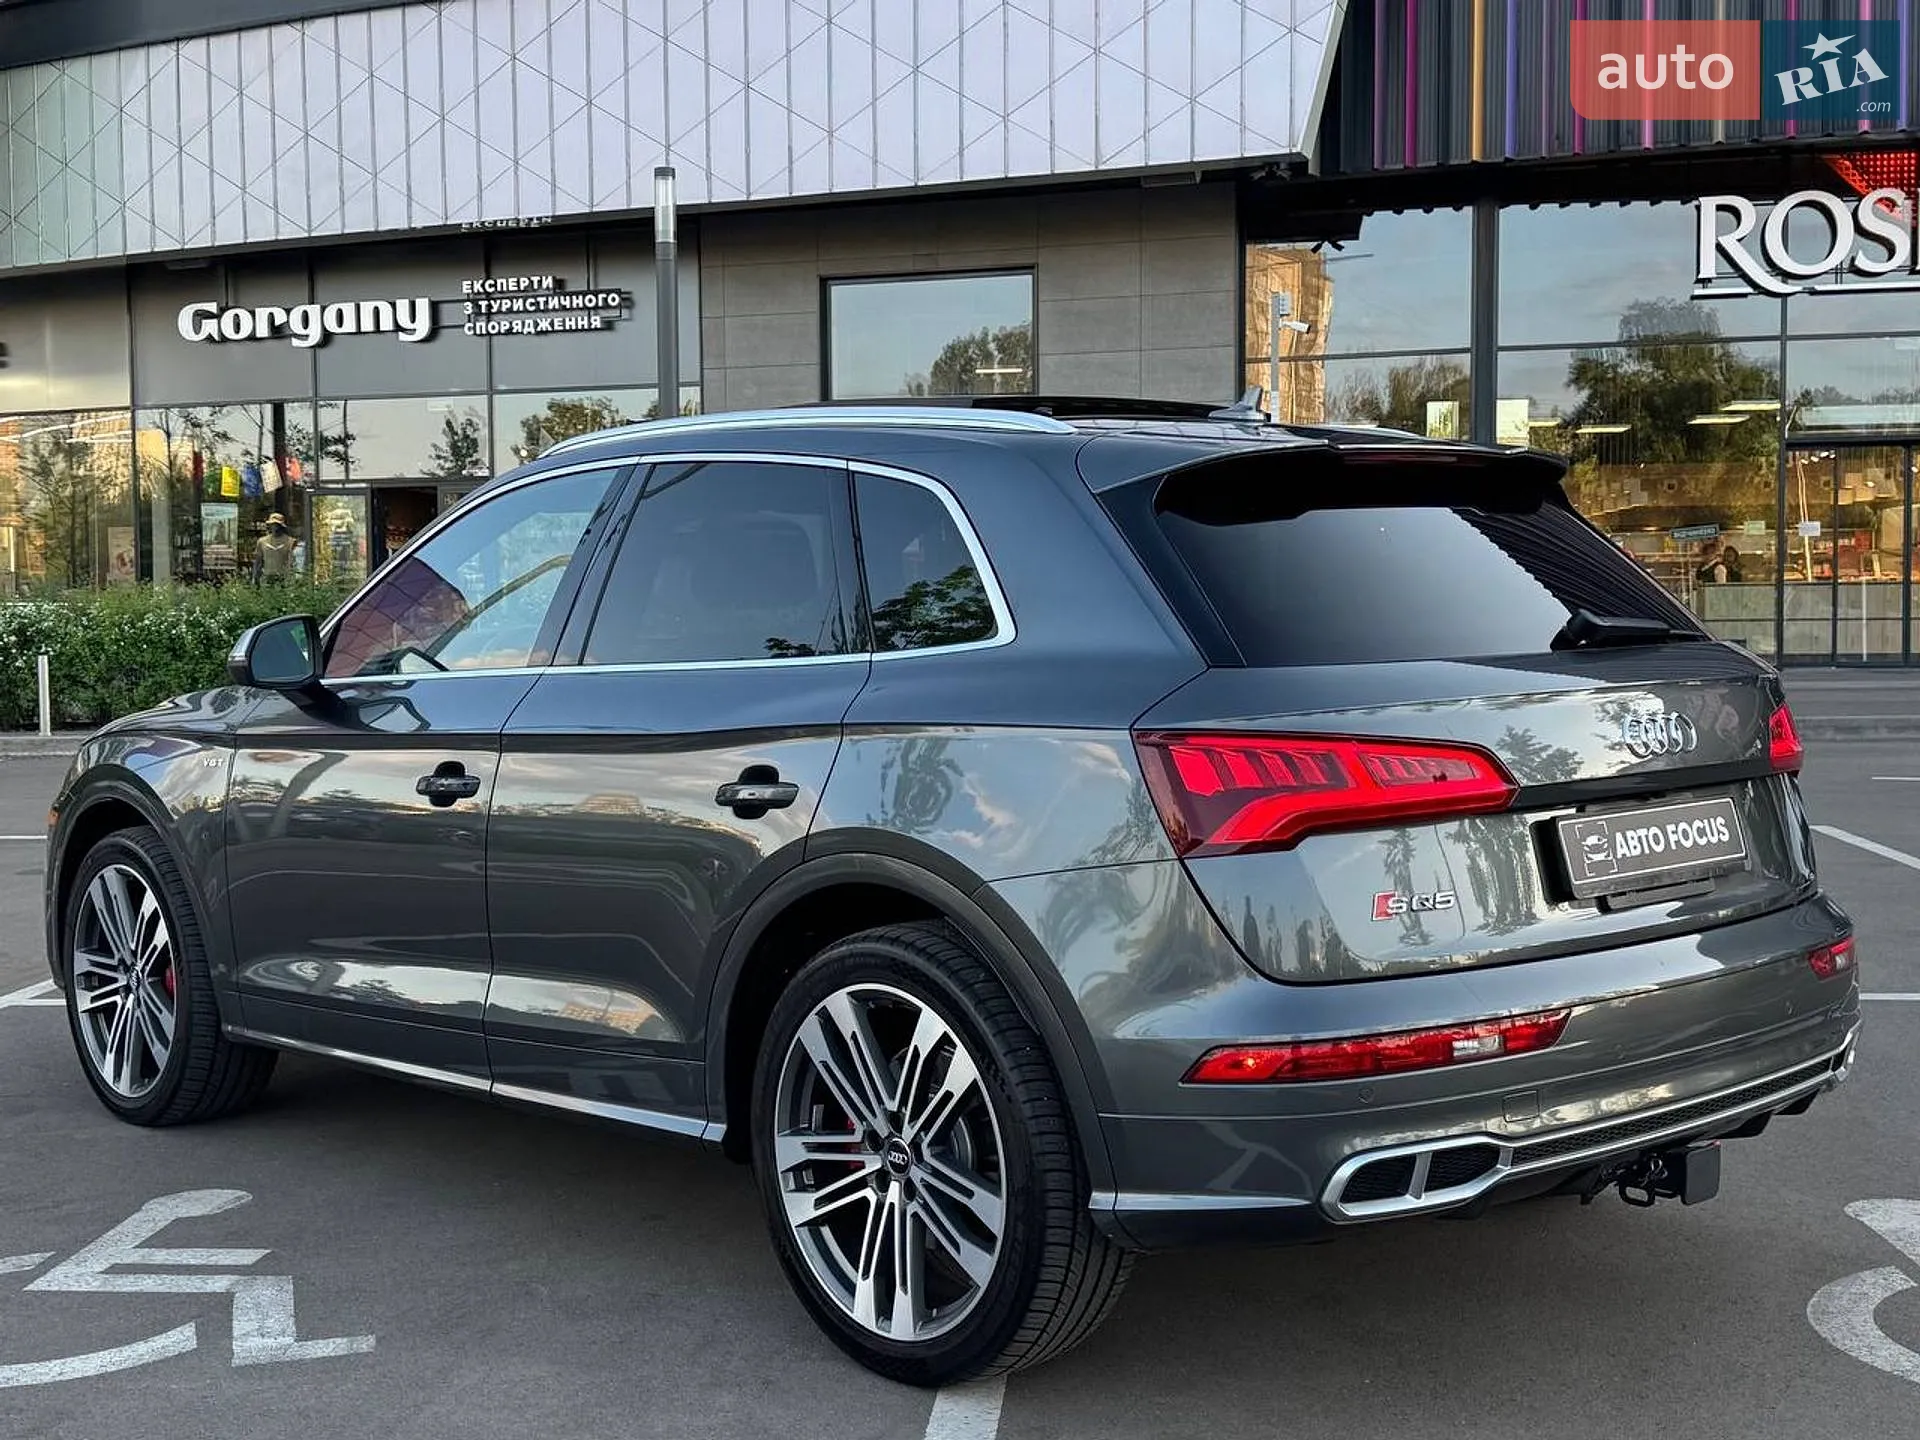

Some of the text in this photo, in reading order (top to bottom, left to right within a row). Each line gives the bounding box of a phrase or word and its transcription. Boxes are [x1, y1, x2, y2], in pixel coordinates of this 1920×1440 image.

[1697, 187, 1920, 295] ROS
[461, 275, 553, 294] ЕКСПЕРТИ
[479, 293, 620, 314] ТУРИСТИЧНОГО
[177, 296, 433, 348] Gorgany
[463, 315, 601, 336] СПОРЯДЖЕННЯ
[1666, 815, 1730, 850] FOCUS
[1385, 890, 1455, 915] SQ5
